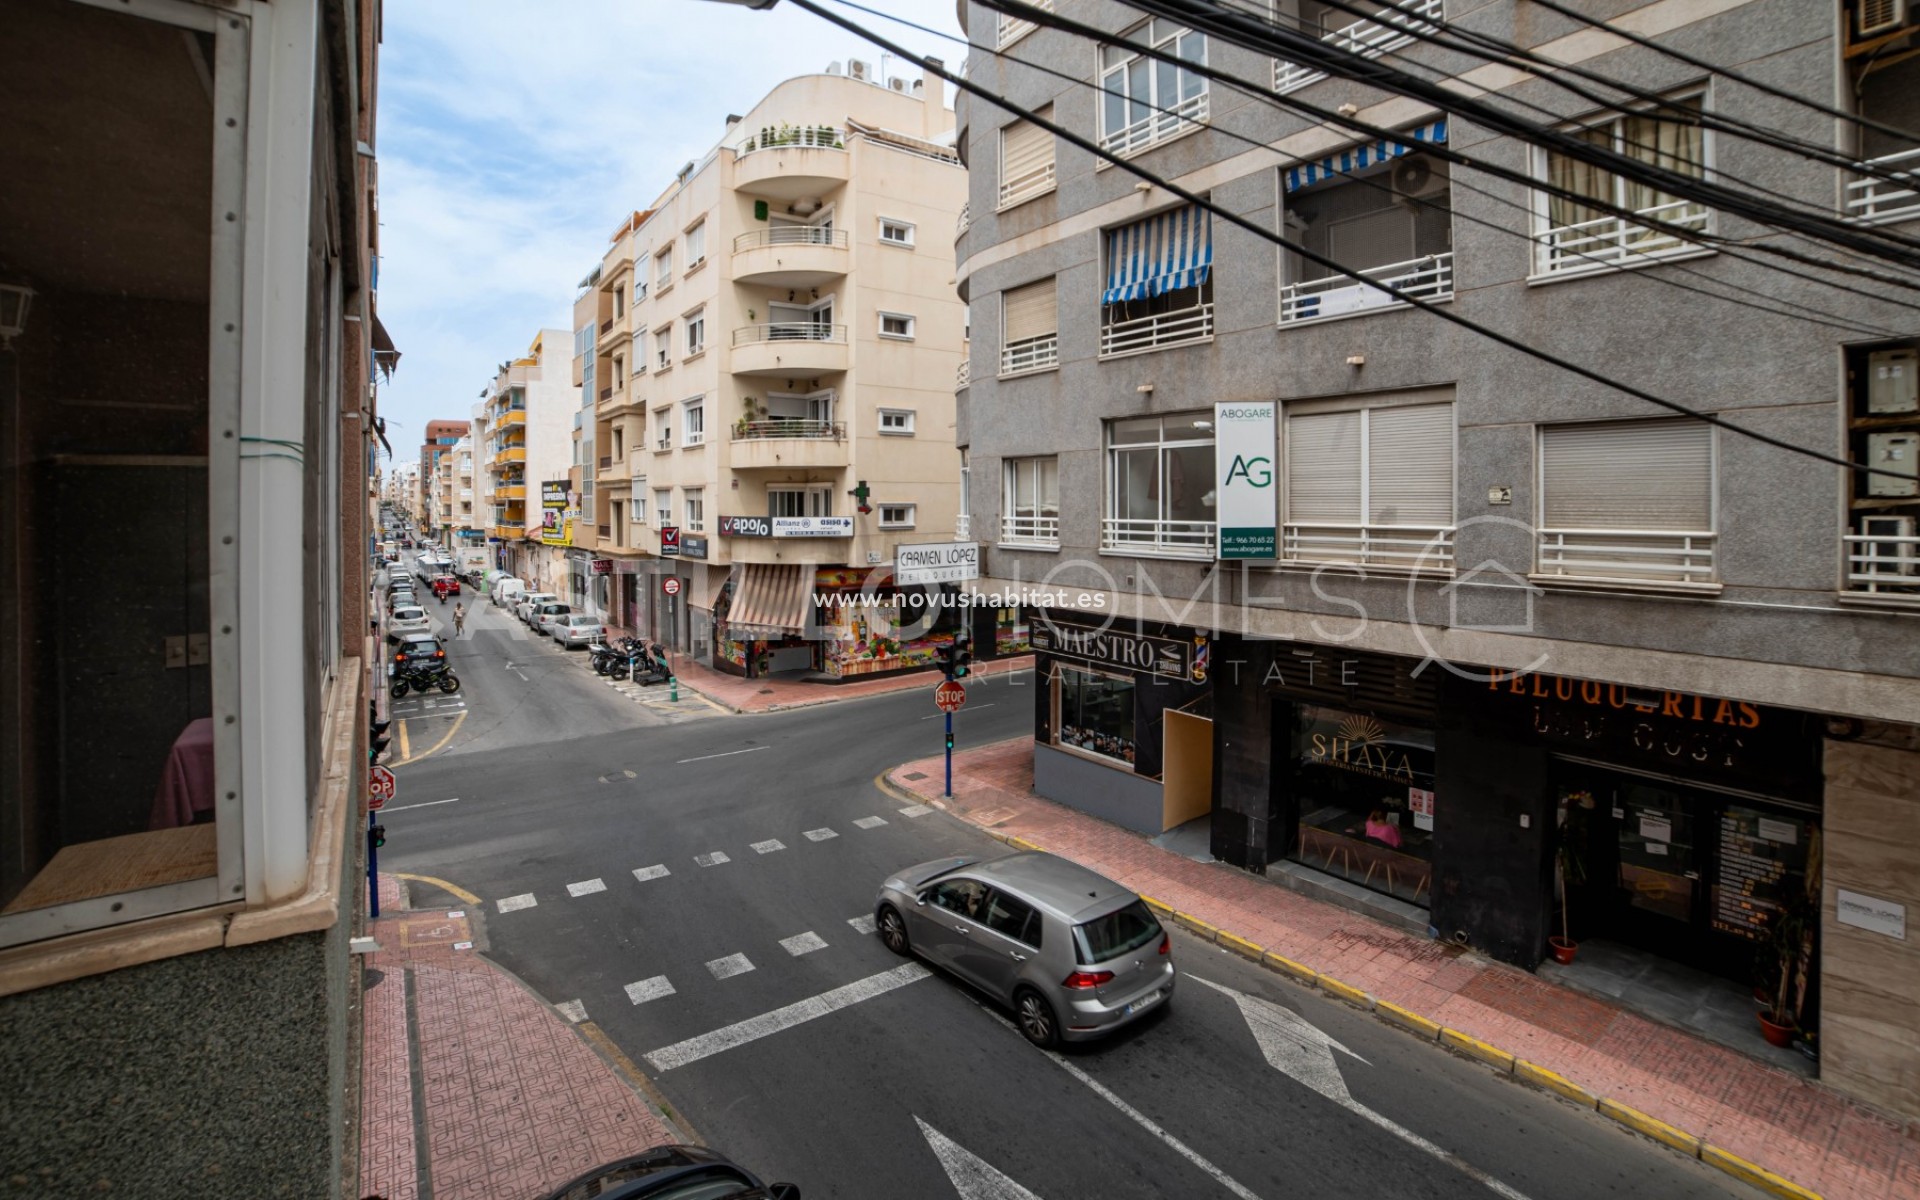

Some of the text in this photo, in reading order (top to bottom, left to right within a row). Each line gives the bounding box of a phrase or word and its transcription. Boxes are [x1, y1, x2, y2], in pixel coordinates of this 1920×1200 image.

[1220, 409, 1273, 419] ABOGARE
[1225, 455, 1271, 488] AG
[901, 550, 941, 567] CARMEN
[947, 544, 977, 564] LÓPEZ
[1223, 546, 1273, 554] www.abogare.es
[1053, 626, 1155, 668] MAESTRO
[937, 690, 965, 703] STOP
[1488, 666, 1760, 729] PELUQURIAS
[1311, 733, 1415, 780] SHAYA
[370, 782, 391, 793] OP
